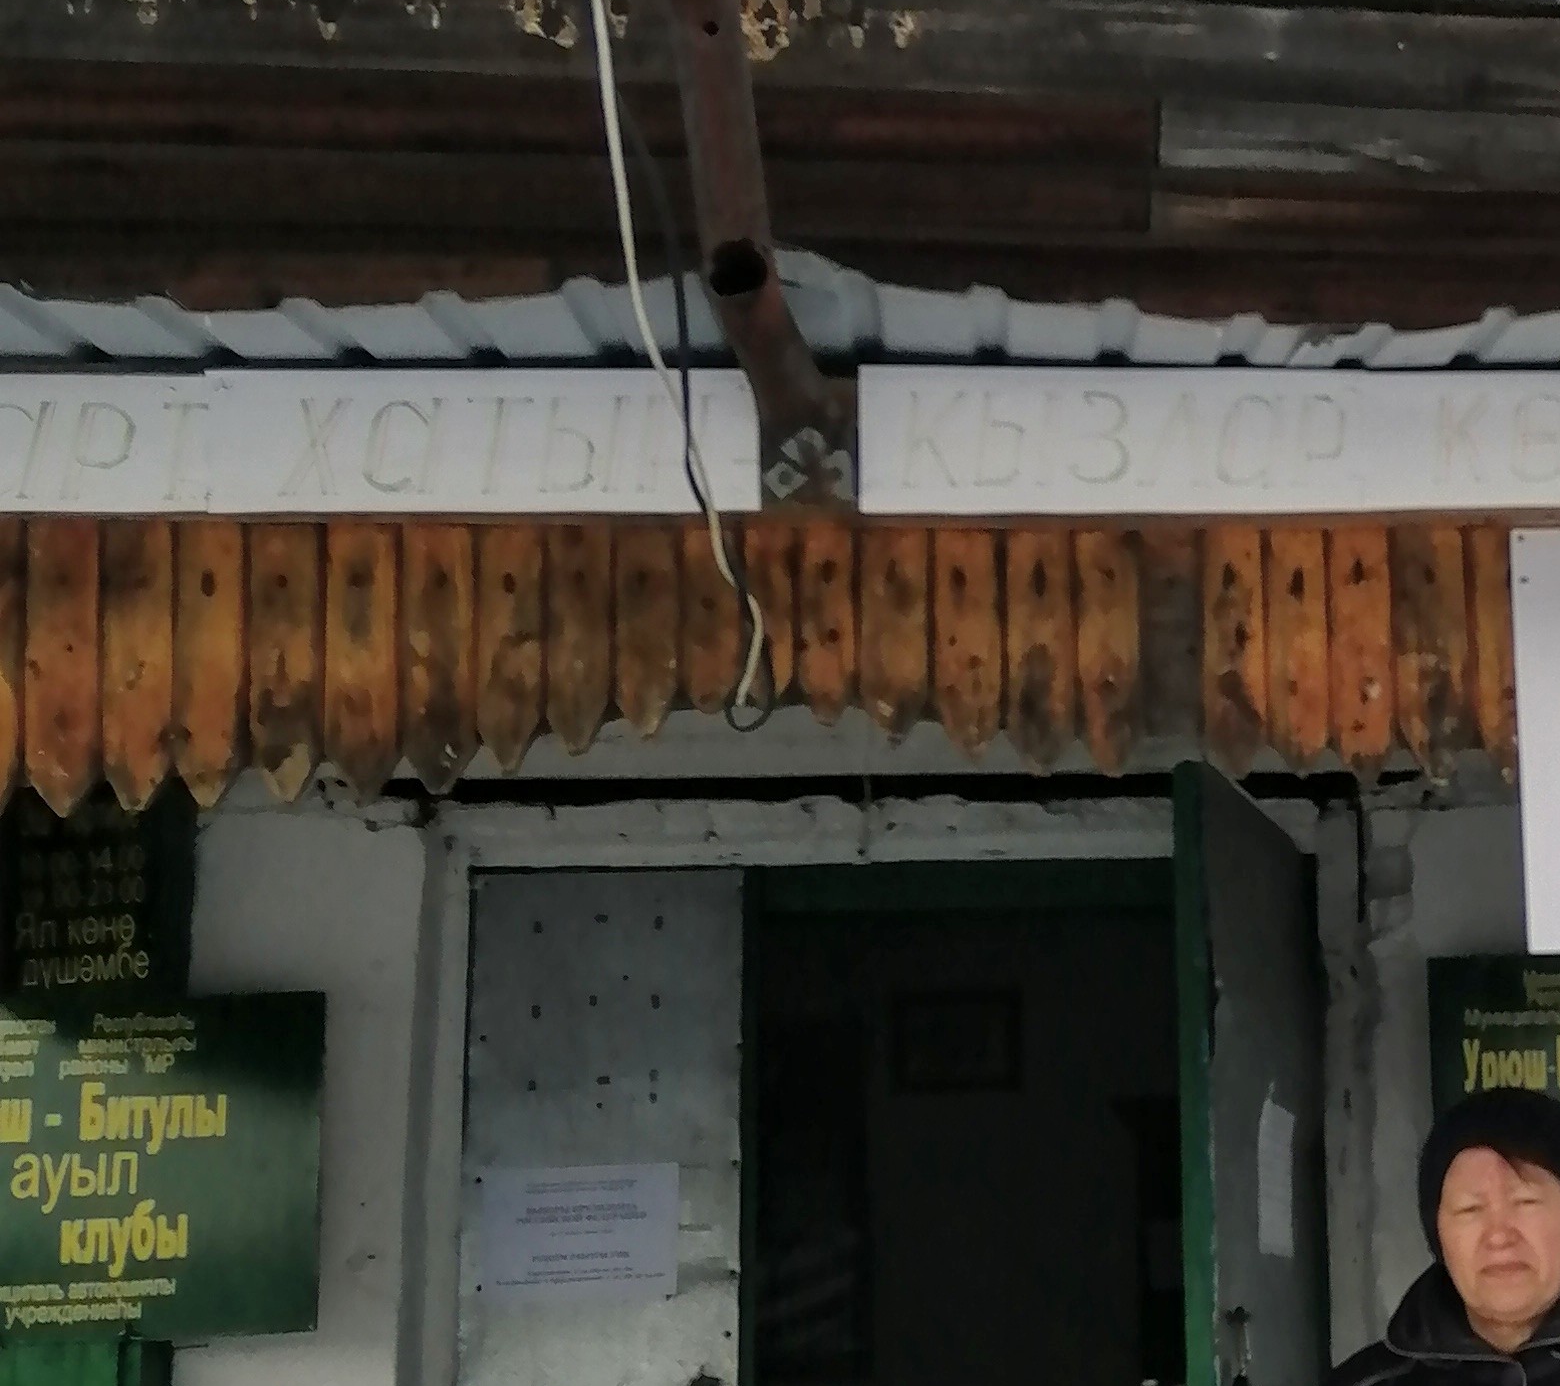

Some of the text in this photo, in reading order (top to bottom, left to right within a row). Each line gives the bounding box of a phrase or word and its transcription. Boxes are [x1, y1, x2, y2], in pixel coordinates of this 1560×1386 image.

[78, 1082, 228, 1155] Битулы
[11, 1150, 140, 1215] ауыл
[59, 1198, 189, 1278] клубы
